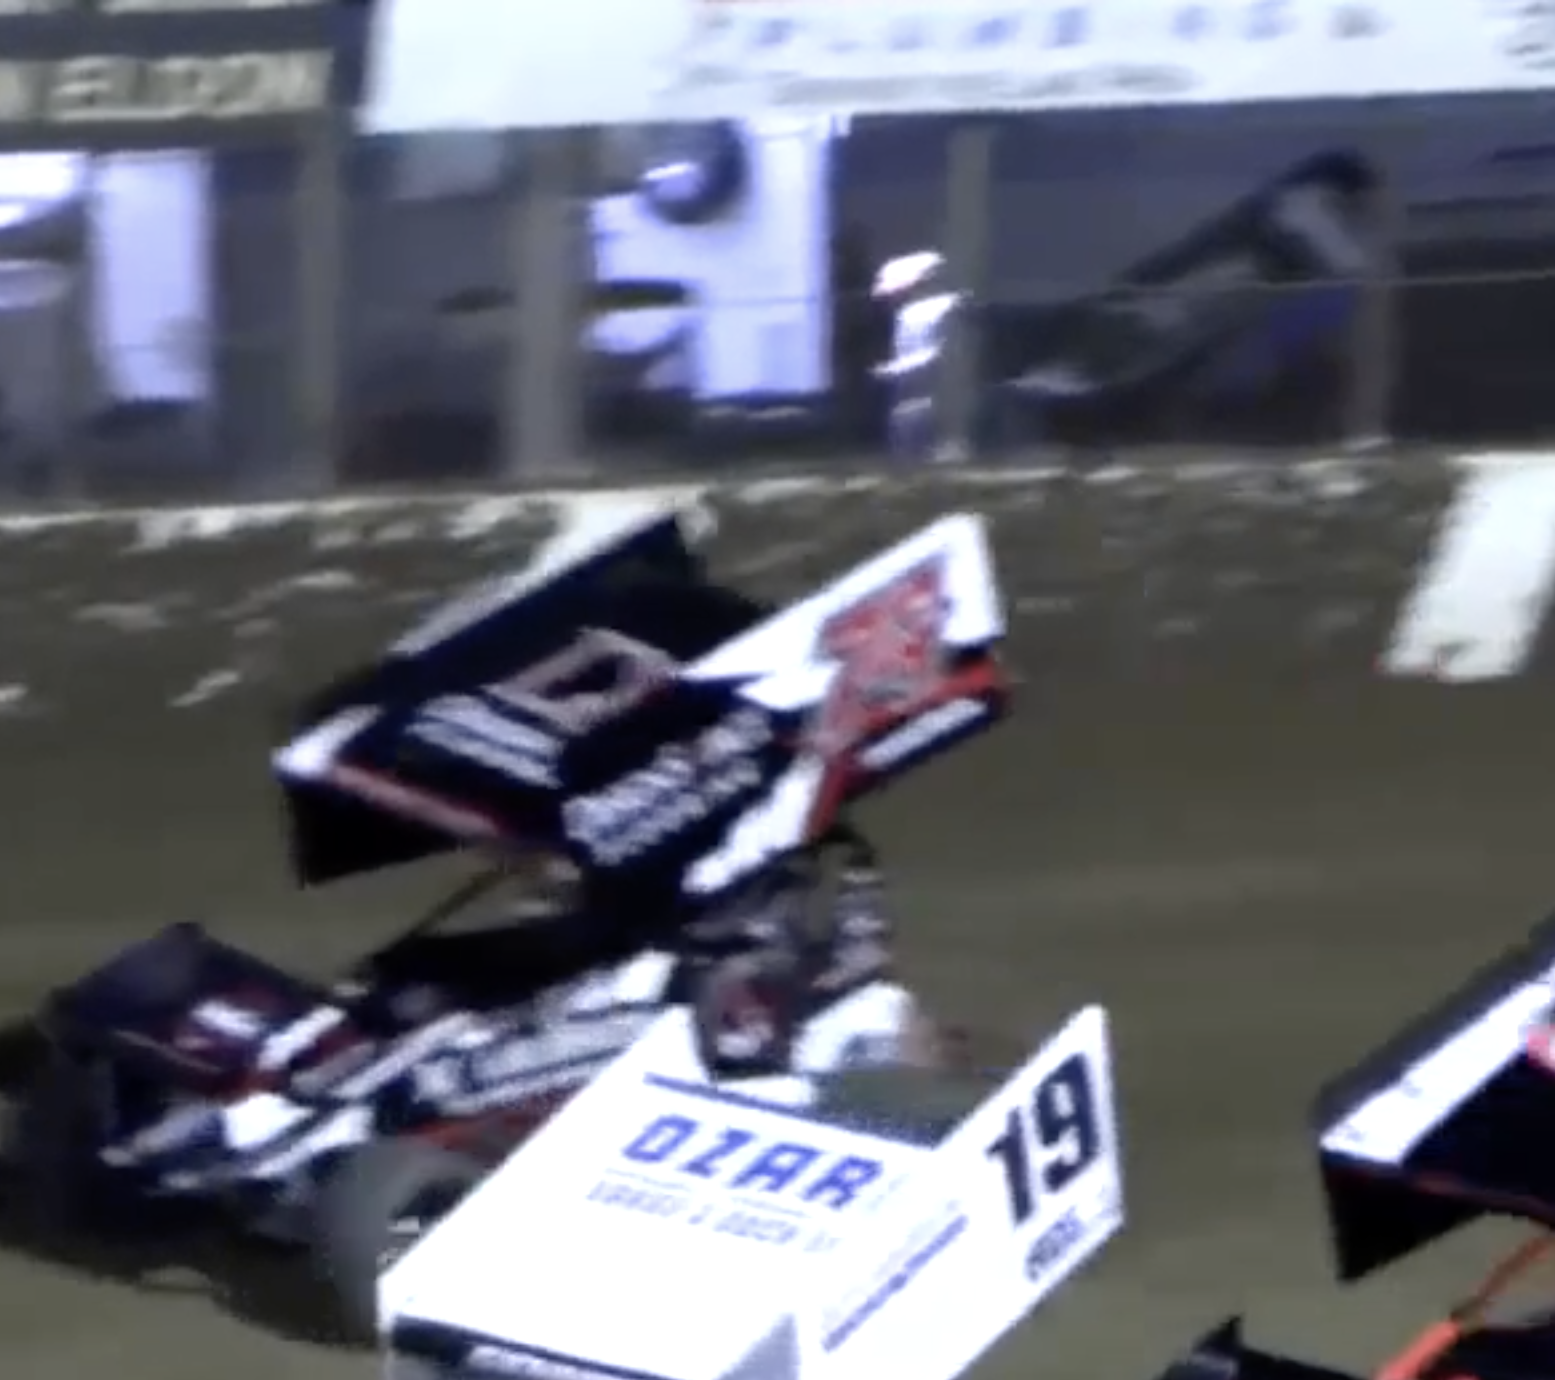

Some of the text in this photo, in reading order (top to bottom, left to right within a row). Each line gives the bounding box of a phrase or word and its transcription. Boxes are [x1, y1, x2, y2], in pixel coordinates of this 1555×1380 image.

[53, 48, 334, 124] ELDON
[619, 1112, 901, 1213] OZAR
[986, 1052, 1094, 1230] 19
